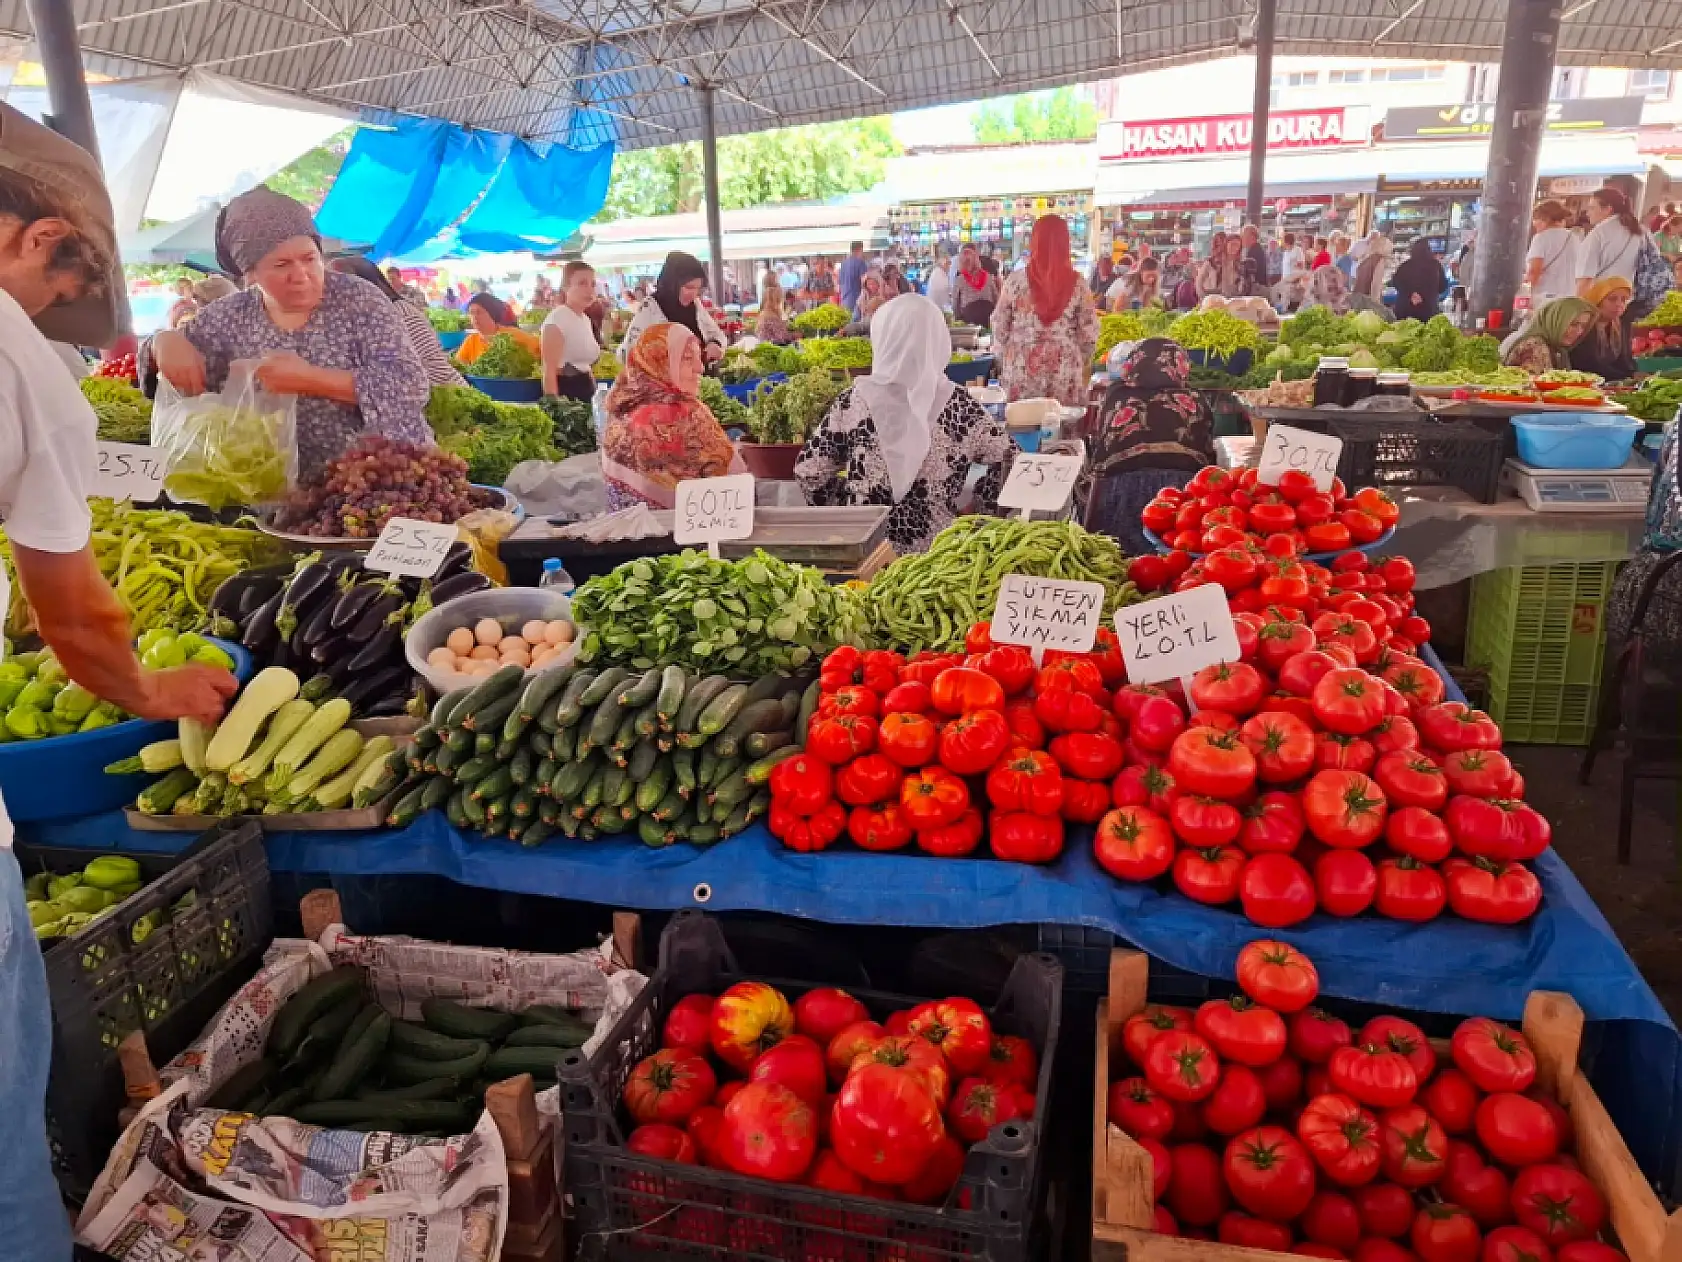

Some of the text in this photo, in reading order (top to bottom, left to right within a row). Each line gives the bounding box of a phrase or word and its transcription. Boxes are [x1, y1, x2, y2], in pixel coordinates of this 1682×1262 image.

[1123, 114, 1343, 152] HASAN KUDURA
[1006, 601, 1087, 627] SIKMA
